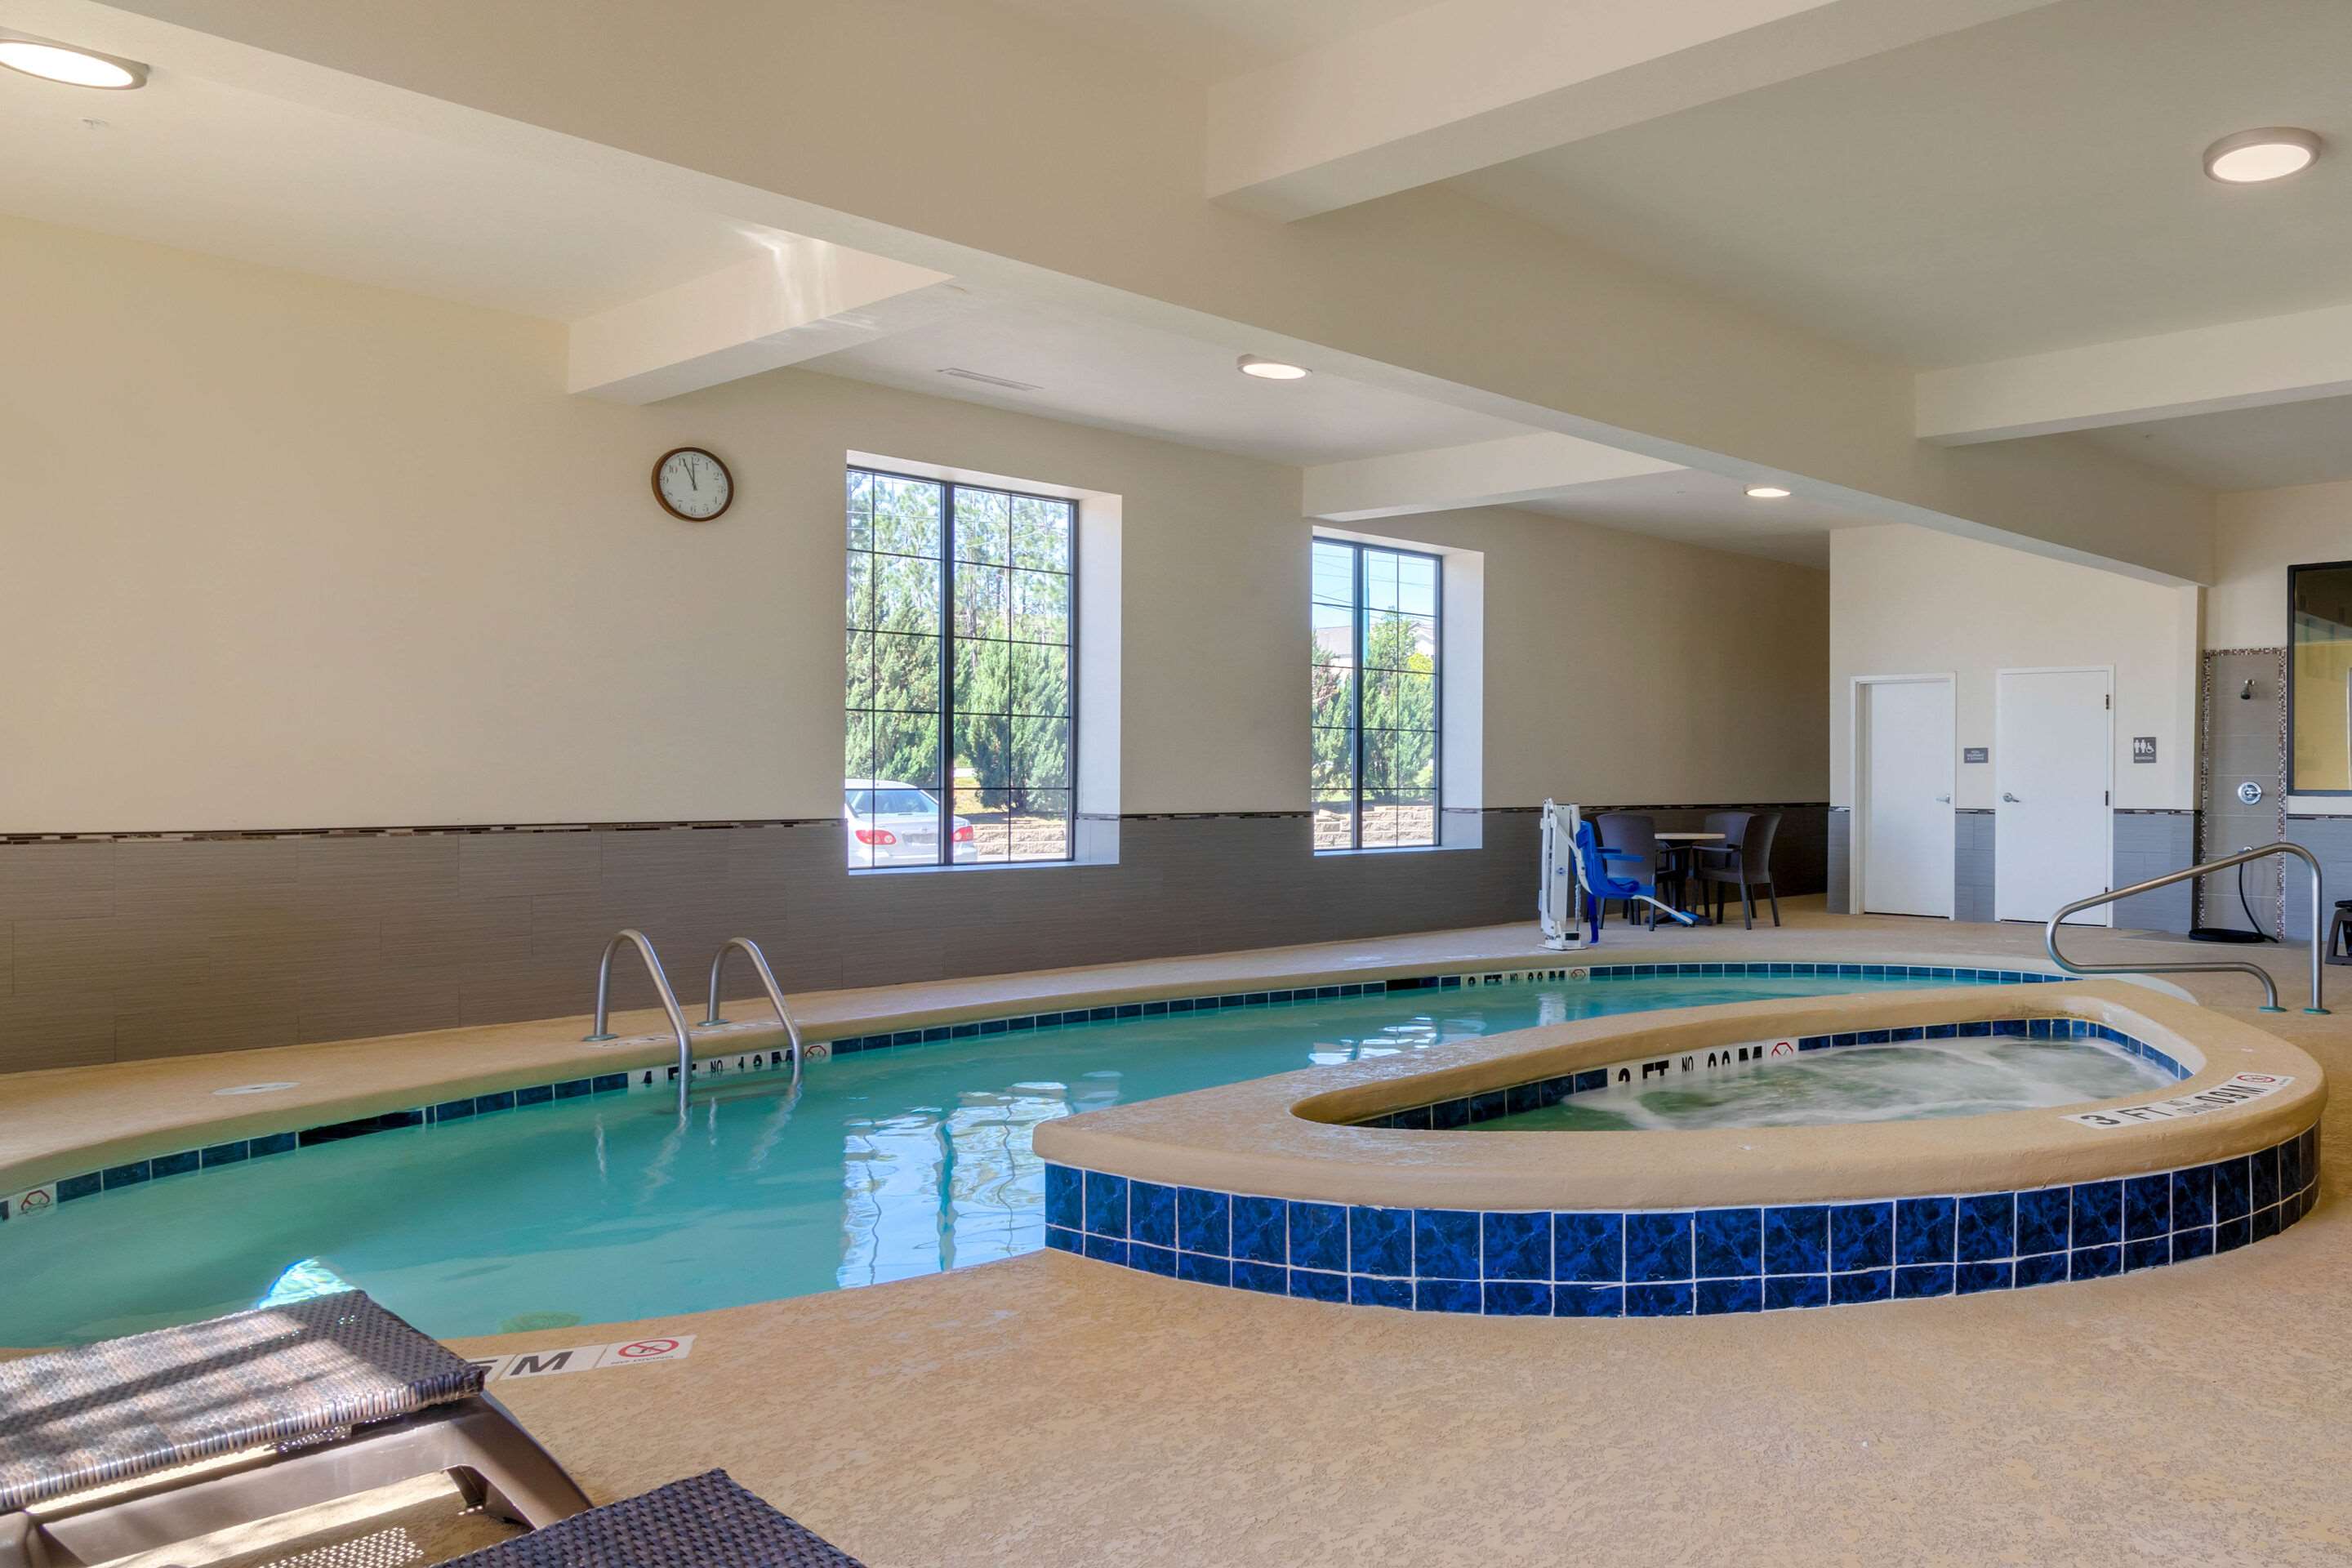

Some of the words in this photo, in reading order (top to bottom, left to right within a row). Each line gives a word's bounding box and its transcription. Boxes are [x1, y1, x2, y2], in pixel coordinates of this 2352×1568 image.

[2080, 1114, 2122, 1126] 3
[2116, 1106, 2175, 1120] FT
[510, 1351, 574, 1376] M
